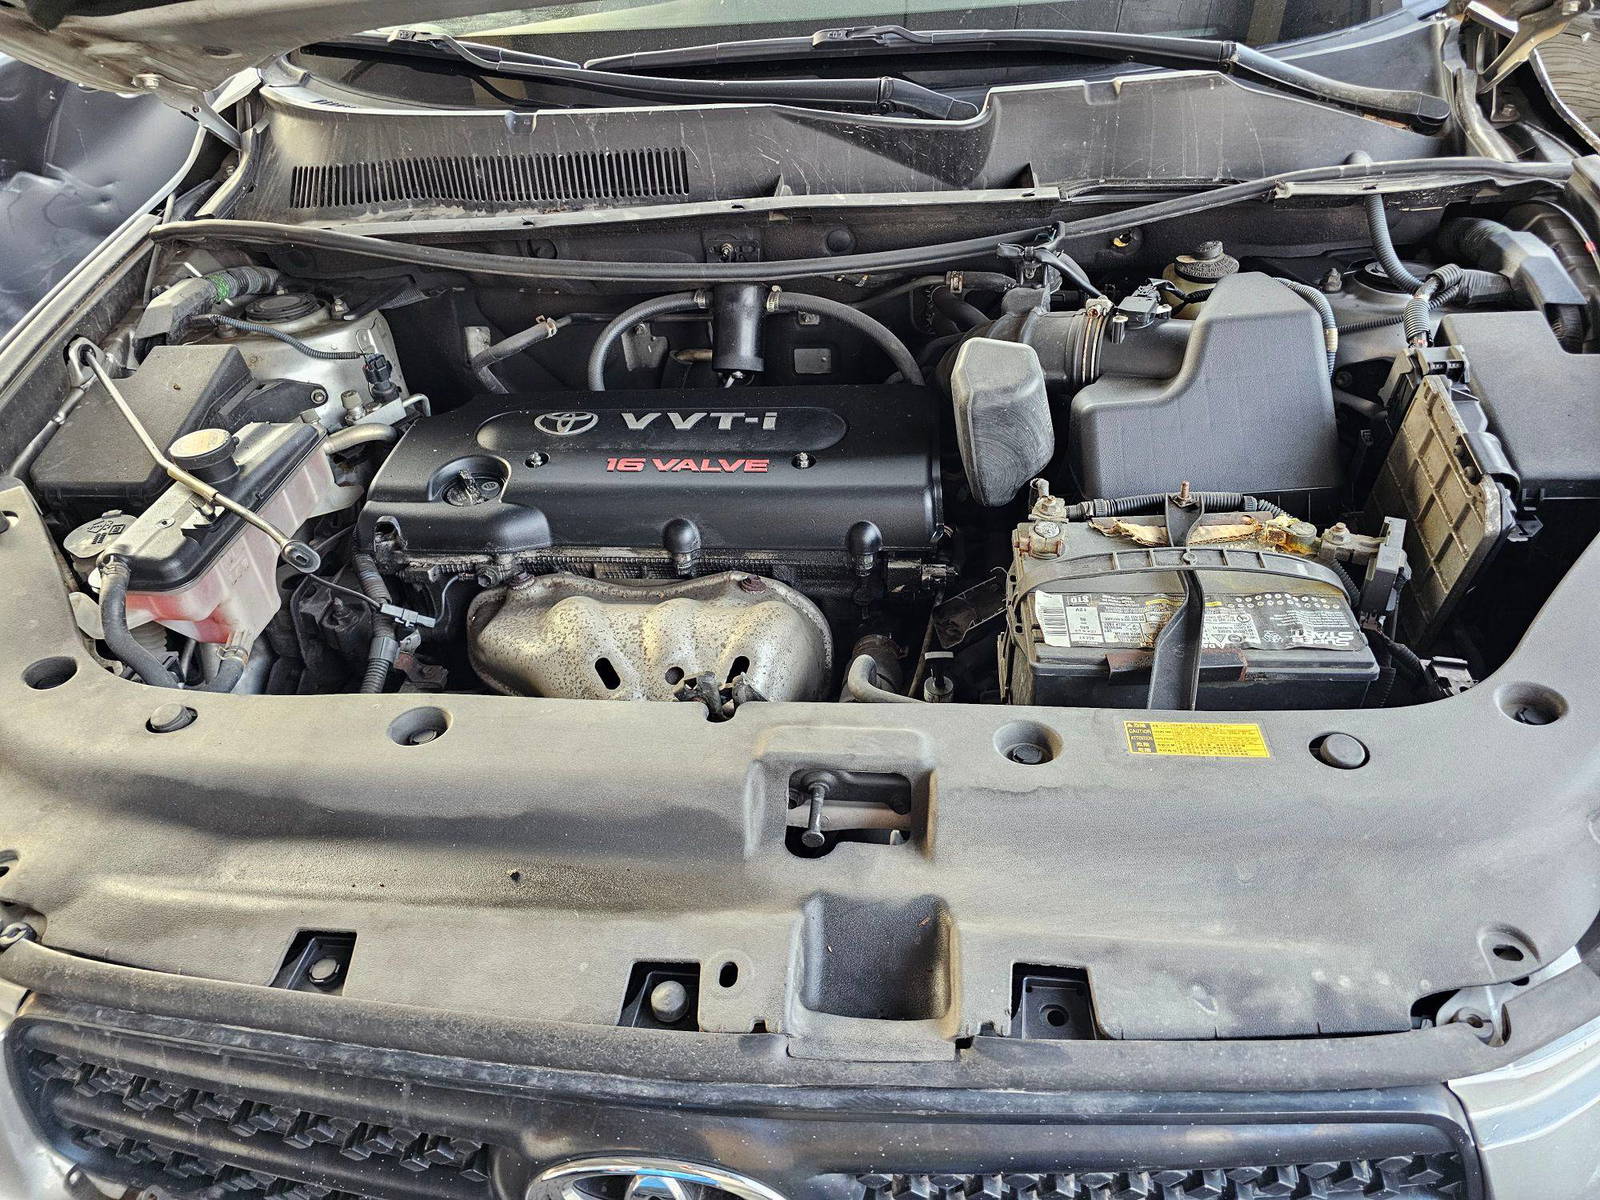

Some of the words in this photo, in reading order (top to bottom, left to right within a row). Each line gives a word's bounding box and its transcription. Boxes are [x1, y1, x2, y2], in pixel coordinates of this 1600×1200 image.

[621, 412, 778, 430] VVT-i
[607, 458, 646, 473] 16
[652, 458, 770, 474] VALVE
